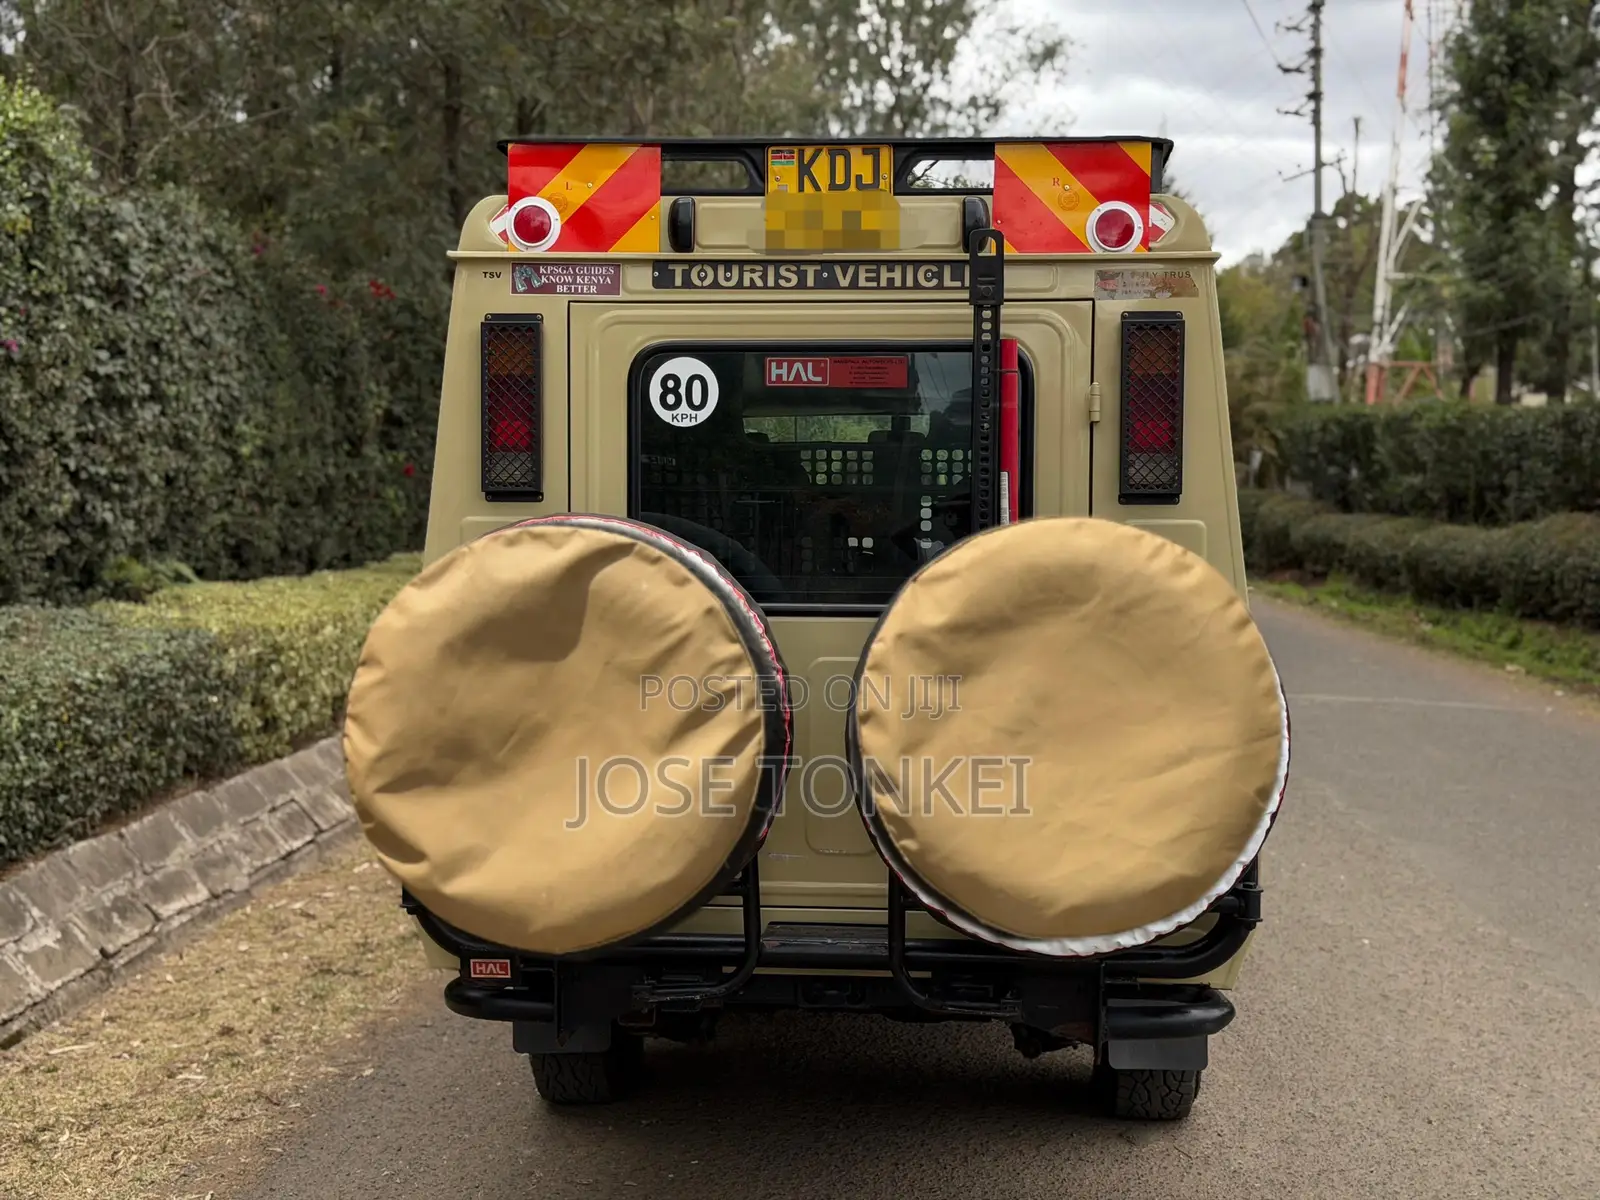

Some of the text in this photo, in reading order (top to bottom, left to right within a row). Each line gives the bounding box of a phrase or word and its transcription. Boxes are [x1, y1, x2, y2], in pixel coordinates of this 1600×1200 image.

[798, 147, 880, 192] KDJ
[565, 181, 573, 191] L
[1052, 177, 1060, 187] R
[482, 271, 502, 279] TSV
[539, 265, 615, 275] KPSGA GUIDES
[1163, 271, 1192, 279] TRUS
[540, 275, 612, 285] KNOW KENYA
[667, 263, 970, 288] TOURIST VEHICL
[556, 284, 598, 294] BETTER
[771, 361, 823, 382] HAL
[659, 372, 709, 412] 80
[671, 413, 698, 423] KPH
[475, 962, 506, 975] HAL
